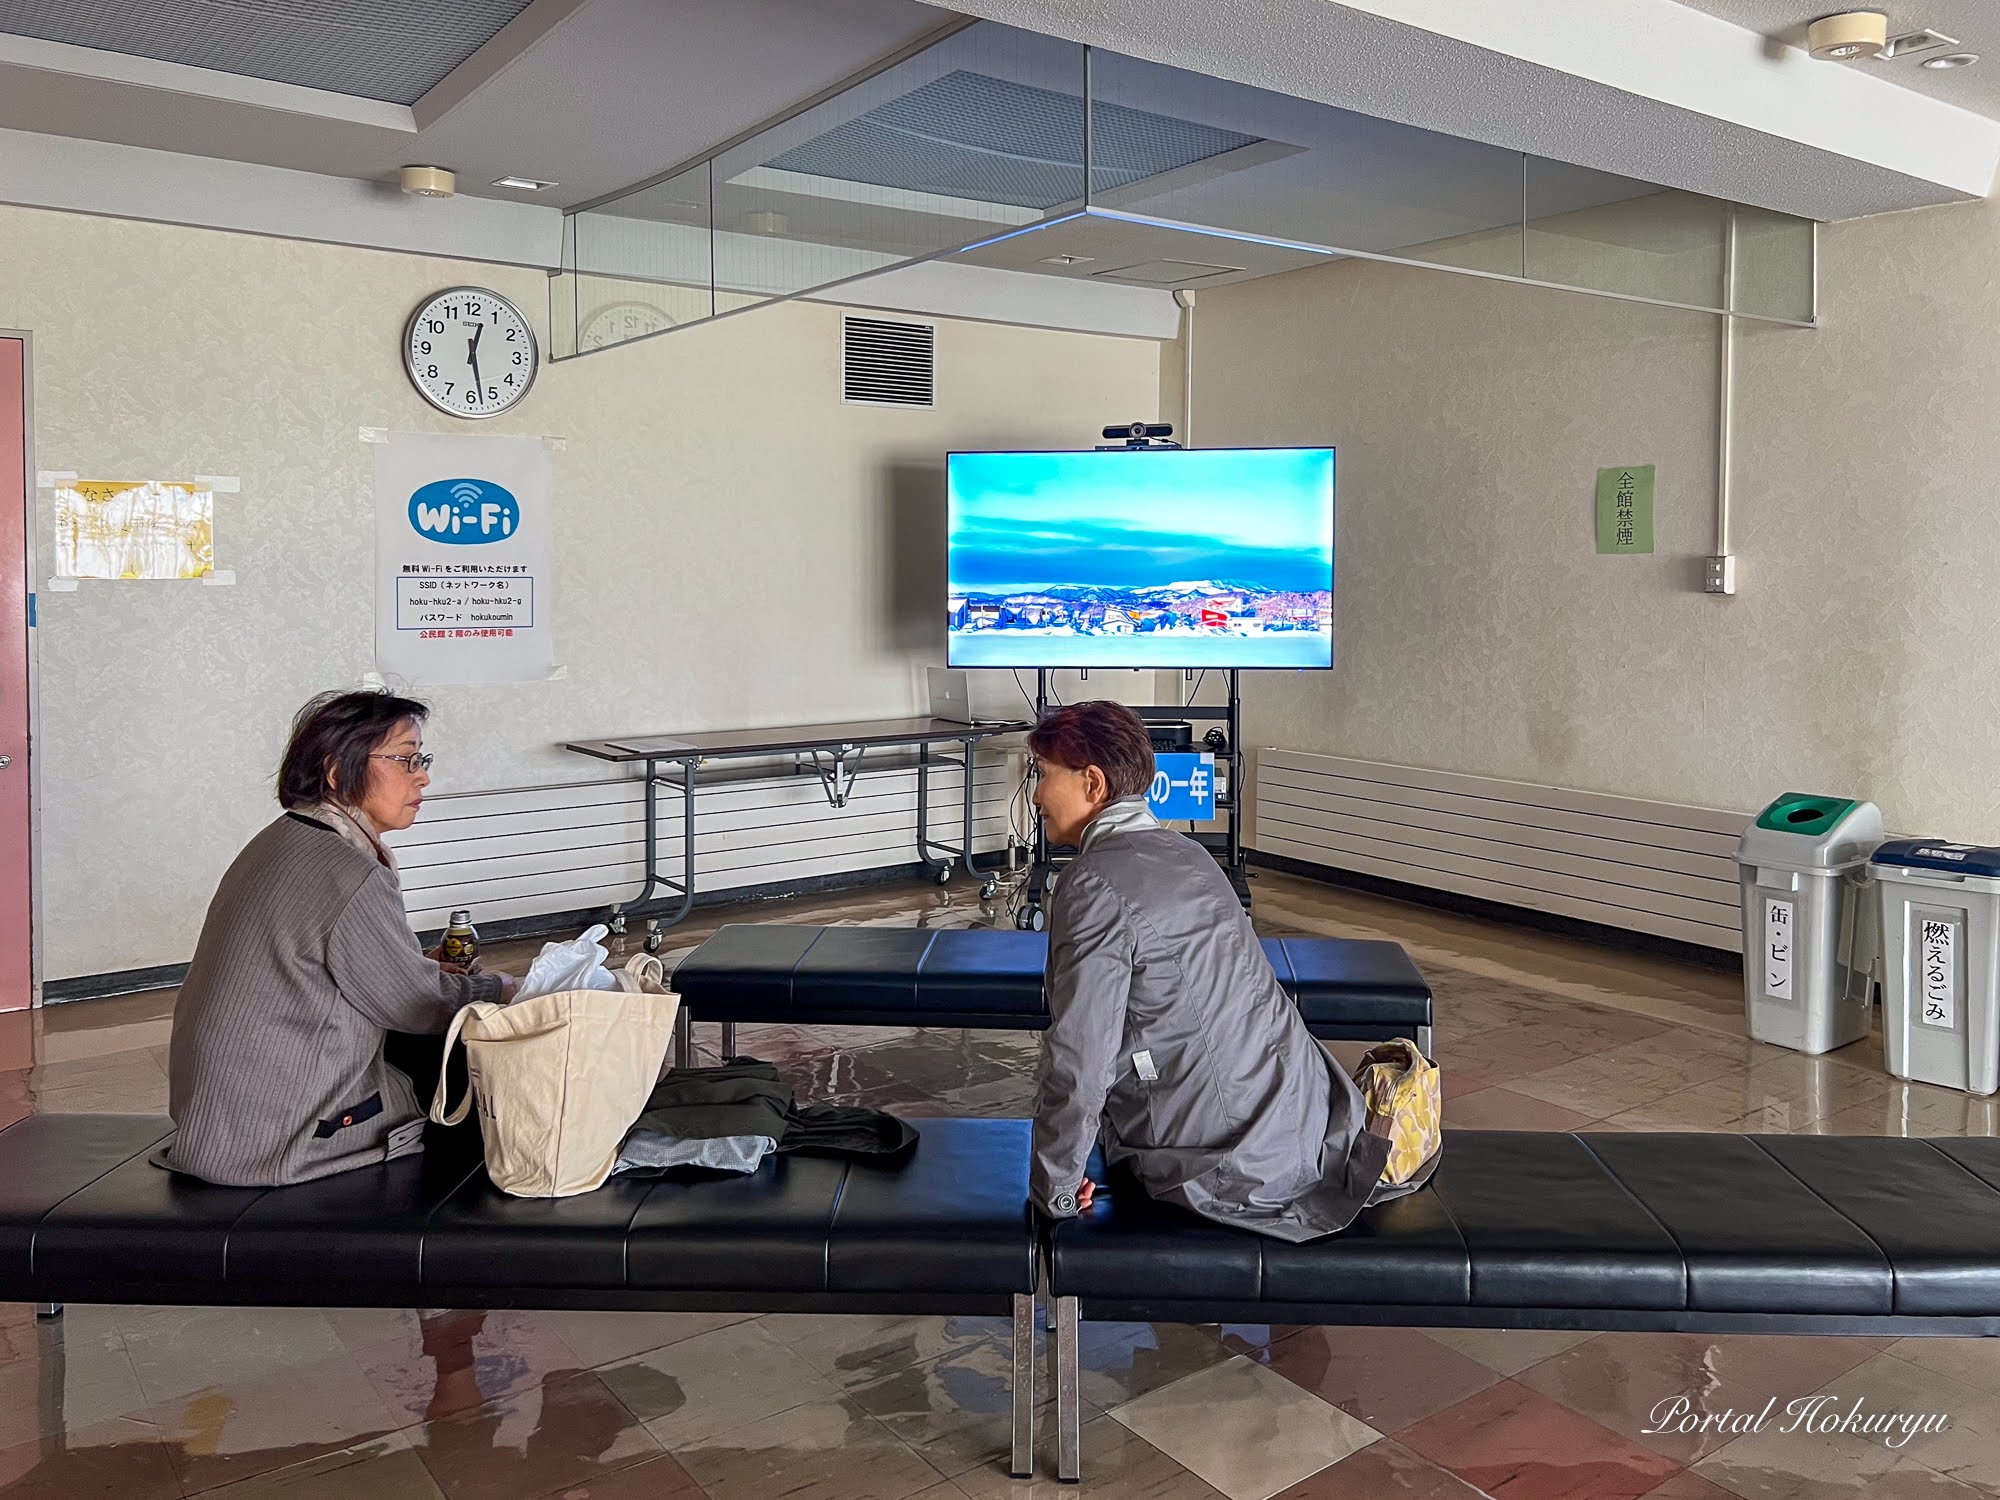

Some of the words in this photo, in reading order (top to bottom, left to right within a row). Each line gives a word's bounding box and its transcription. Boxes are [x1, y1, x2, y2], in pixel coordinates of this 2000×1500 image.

[444, 305, 458, 320] 11
[464, 302, 481, 316] 12
[491, 311, 498, 324] 1
[426, 319, 445, 334] 10
[505, 328, 516, 341] 2
[420, 341, 431, 354] 9
[511, 351, 522, 365] 3
[427, 364, 438, 378] 8
[503, 372, 514, 386] 4
[444, 381, 455, 395] 7
[487, 386, 498, 399] 5
[465, 390, 476, 403] 6
[1616, 471, 1634, 546] 全館禁煙
[417, 502, 511, 535] Wi-Fi
[409, 598, 462, 606] hoku-hku2-a
[470, 613, 514, 621] hokukoumin
[1144, 767, 1209, 806] の一年
[1923, 921, 1950, 1021] 燃えるごみ
